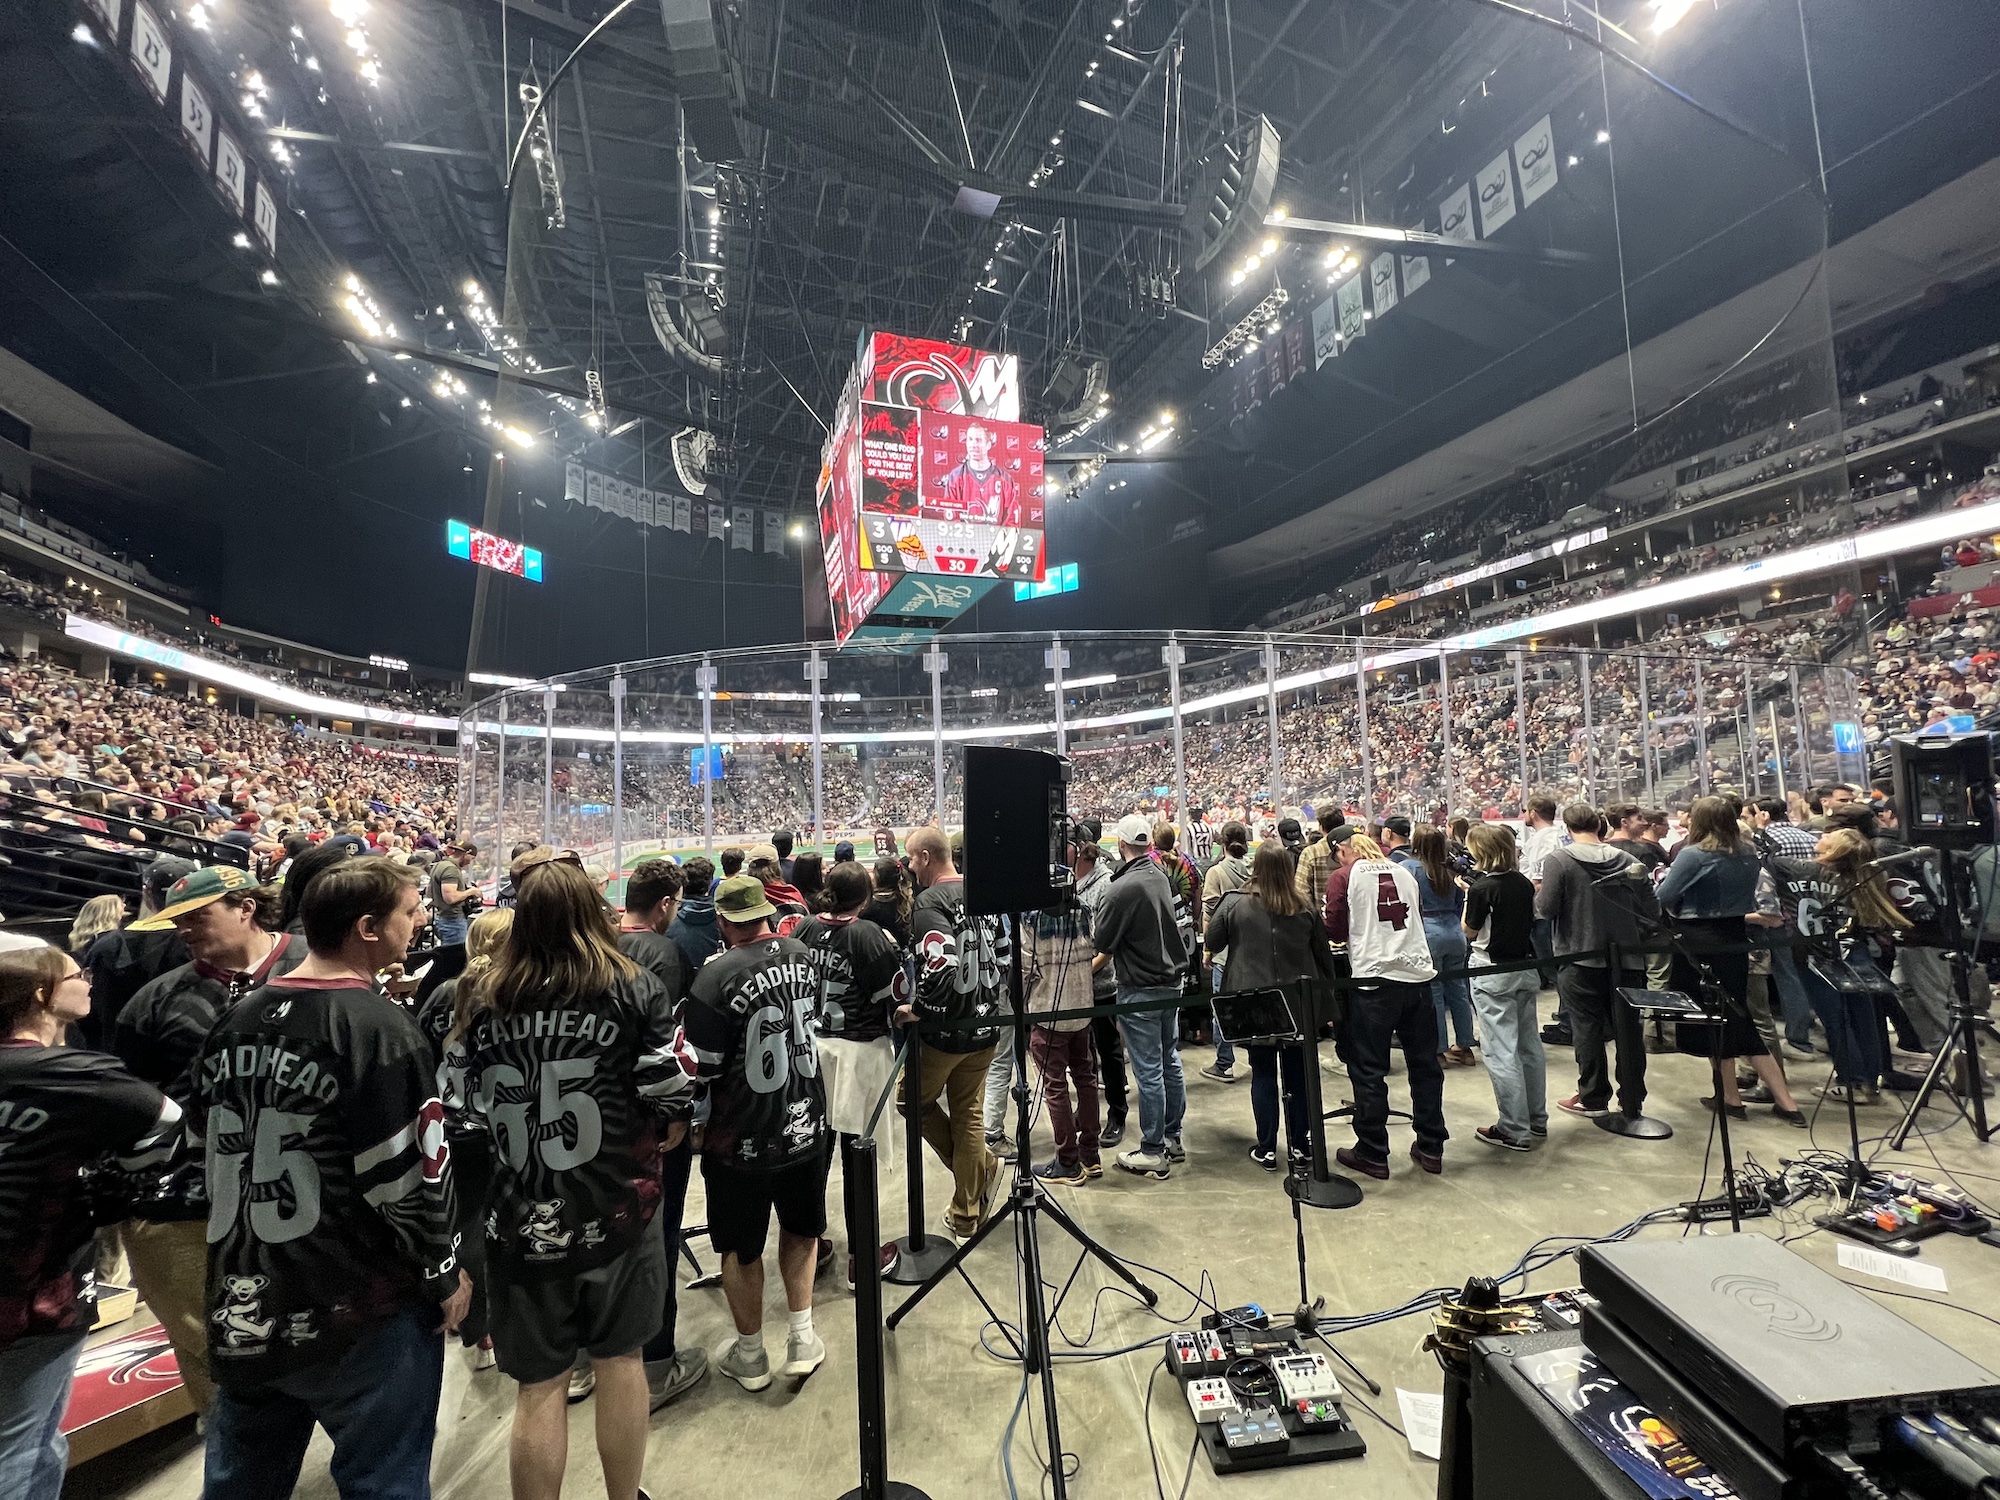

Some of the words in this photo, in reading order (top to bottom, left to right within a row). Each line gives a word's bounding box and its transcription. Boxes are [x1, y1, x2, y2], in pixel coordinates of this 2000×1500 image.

[864, 440, 884, 450] WHAT
[884, 442, 898, 452] ONE
[898, 444, 916, 453] FOOD
[865, 449, 888, 459] COULD
[888, 452, 902, 461] YOU
[902, 454, 915, 462] EAT
[868, 458, 882, 468] FOR
[882, 460, 895, 469] THE
[895, 461, 912, 471] REST
[867, 468, 877, 476] OF
[877, 469, 895, 479] YOUR
[895, 471, 913, 480] LIFE?
[872, 521, 886, 539] 3
[937, 521, 975, 539] 9:25
[875, 544, 894, 554] SOG
[1022, 534, 1035, 551] 2
[880, 552, 890, 565] 5
[1016, 555, 1032, 565] SOG
[948, 559, 967, 572] 30
[1019, 563, 1029, 575] 4
[877, 839, 887, 848] 55
[1196, 833, 1210, 845] 27
[1377, 873, 1410, 931] 4
[729, 963, 817, 1014] DEADHEA
[745, 996, 817, 1094] 65
[481, 1055, 602, 1174] 65
